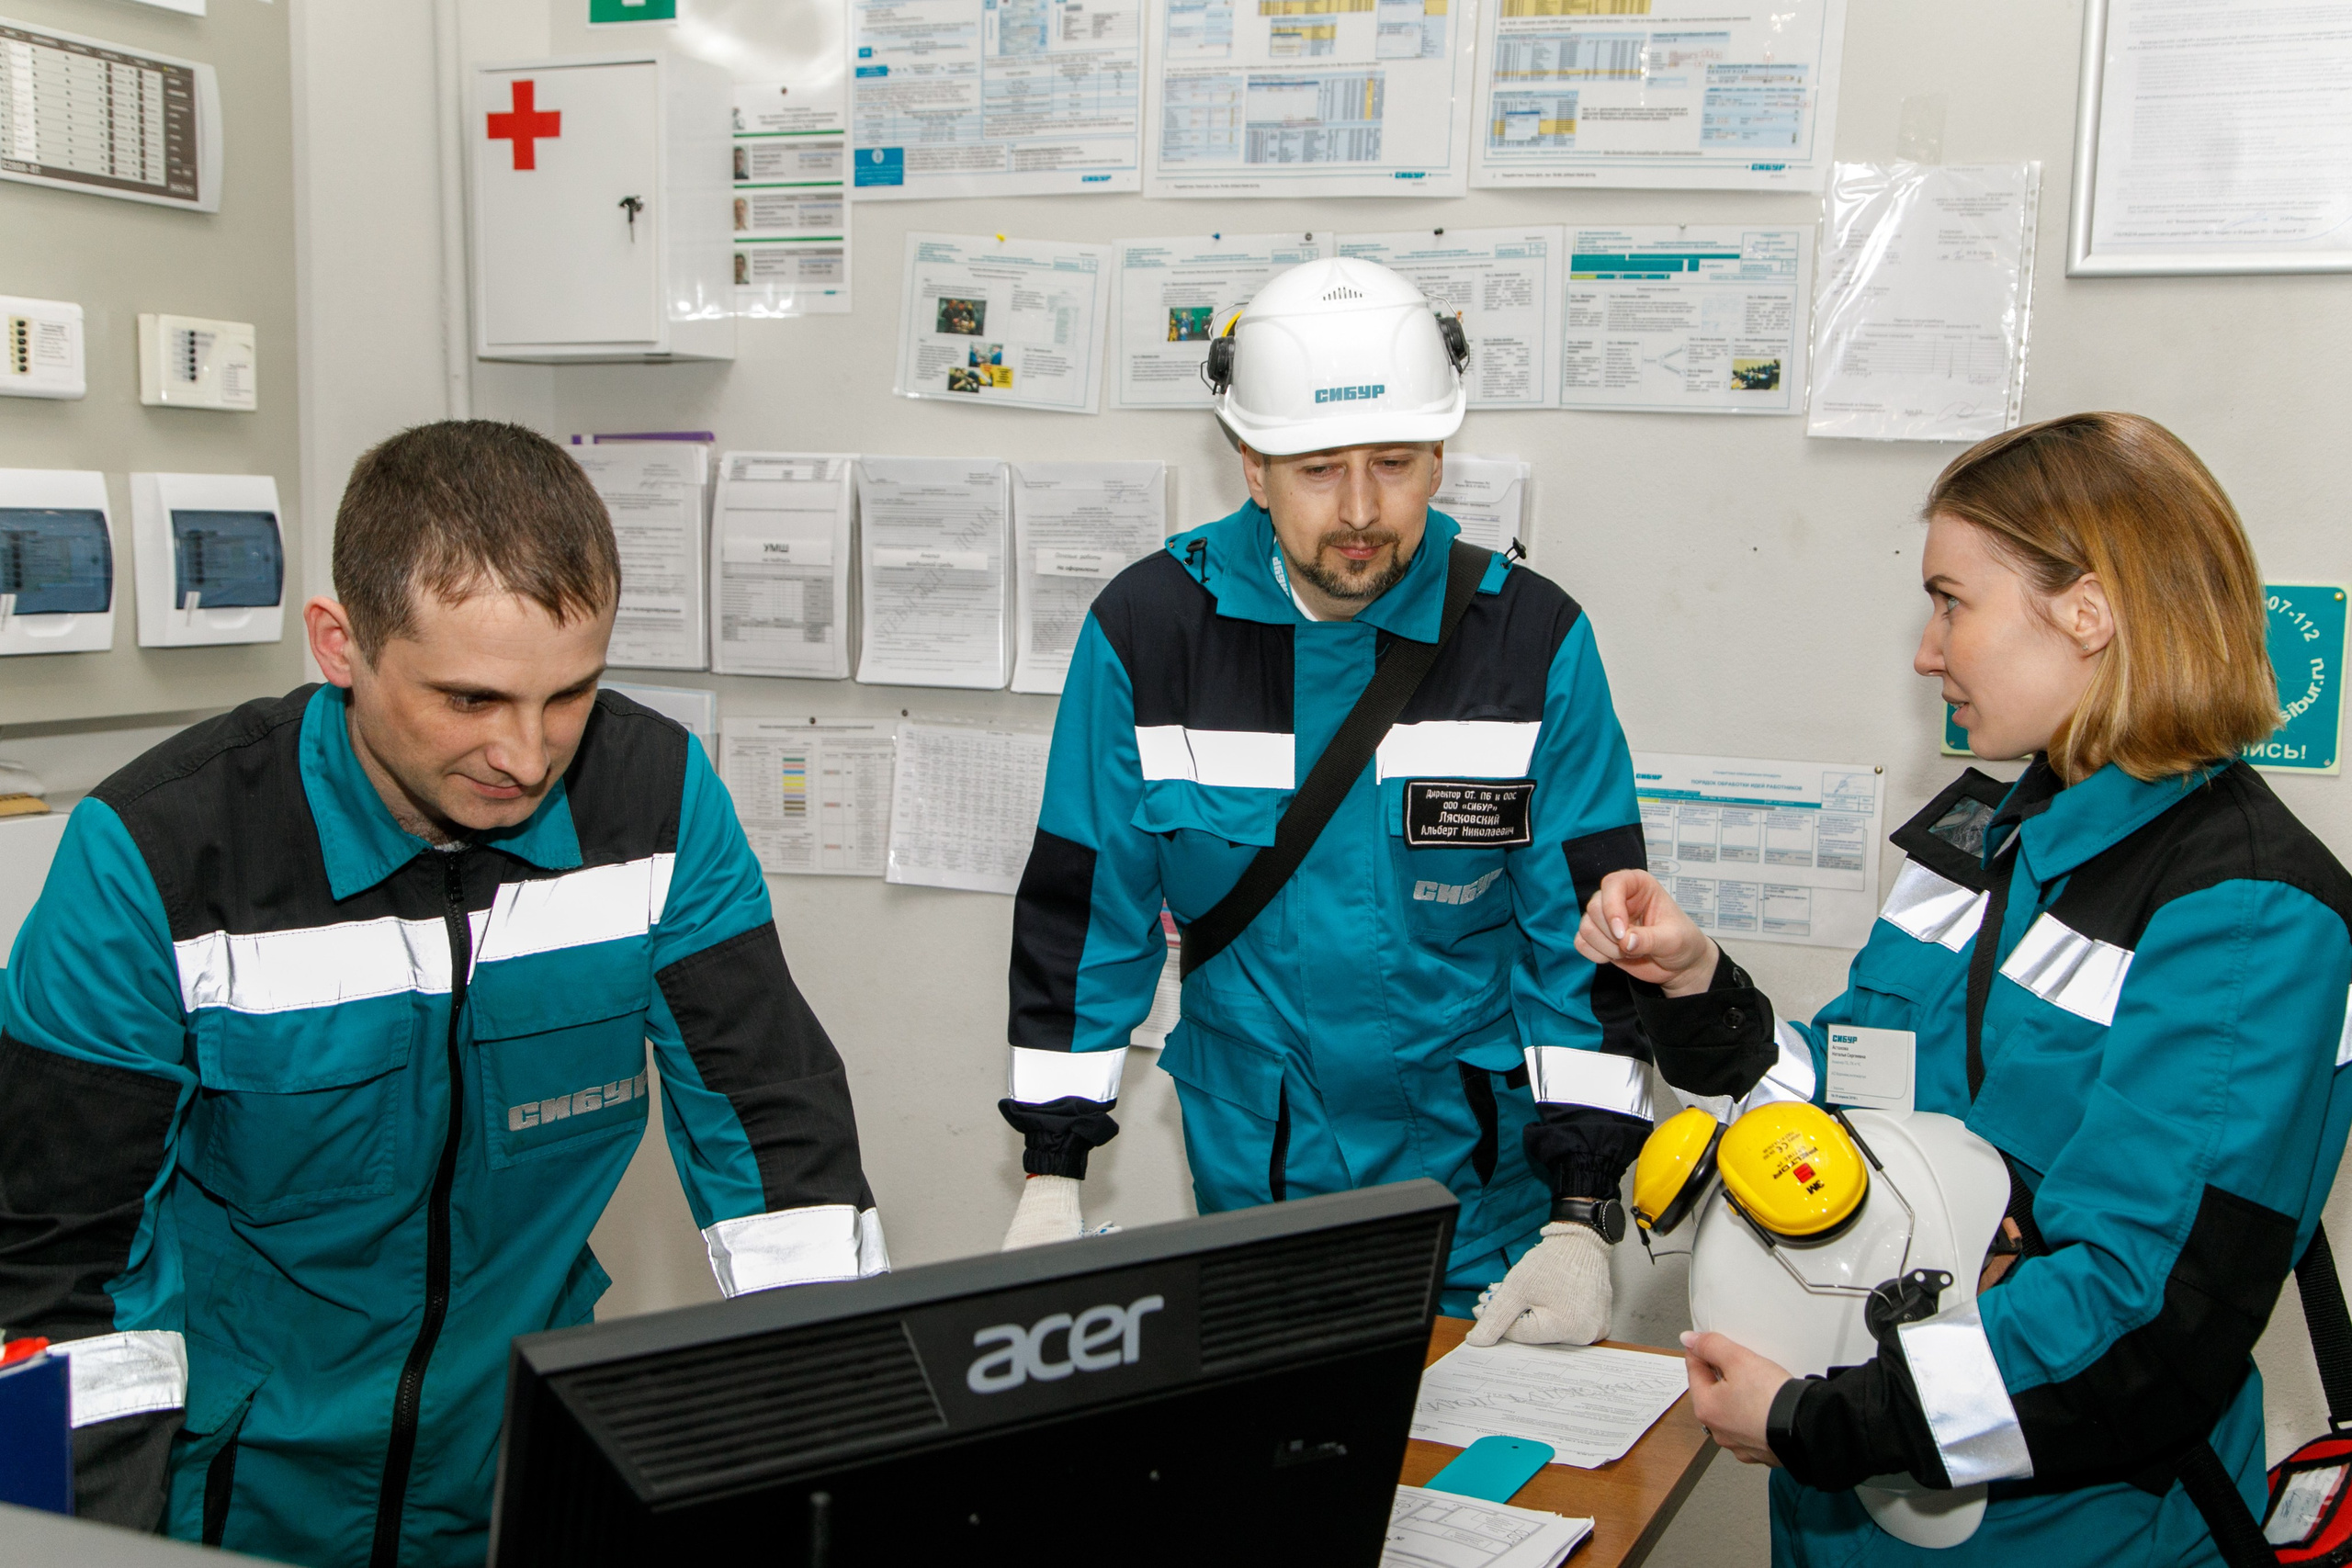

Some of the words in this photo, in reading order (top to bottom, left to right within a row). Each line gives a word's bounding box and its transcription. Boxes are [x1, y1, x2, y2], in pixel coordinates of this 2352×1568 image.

[1315, 384, 1385, 404] СИБУР
[1425, 789, 1461, 800] Директор
[1480, 791, 1492, 801] ПБ
[1503, 792, 1518, 801] ООС
[1442, 801, 1458, 809] ООО
[1462, 802, 1498, 812] «СИБУР»
[1439, 811, 1500, 825] Лясковский
[1421, 825, 1459, 837] Альберт
[1462, 826, 1514, 837] Николаевич
[1413, 867, 1504, 905] СИБУР
[1832, 1034, 1858, 1043] СИБУР
[1773, 1146, 1818, 1179] PELTOR
[1806, 1179, 1825, 1195] 3M
[967, 1294, 1165, 1394] acer
